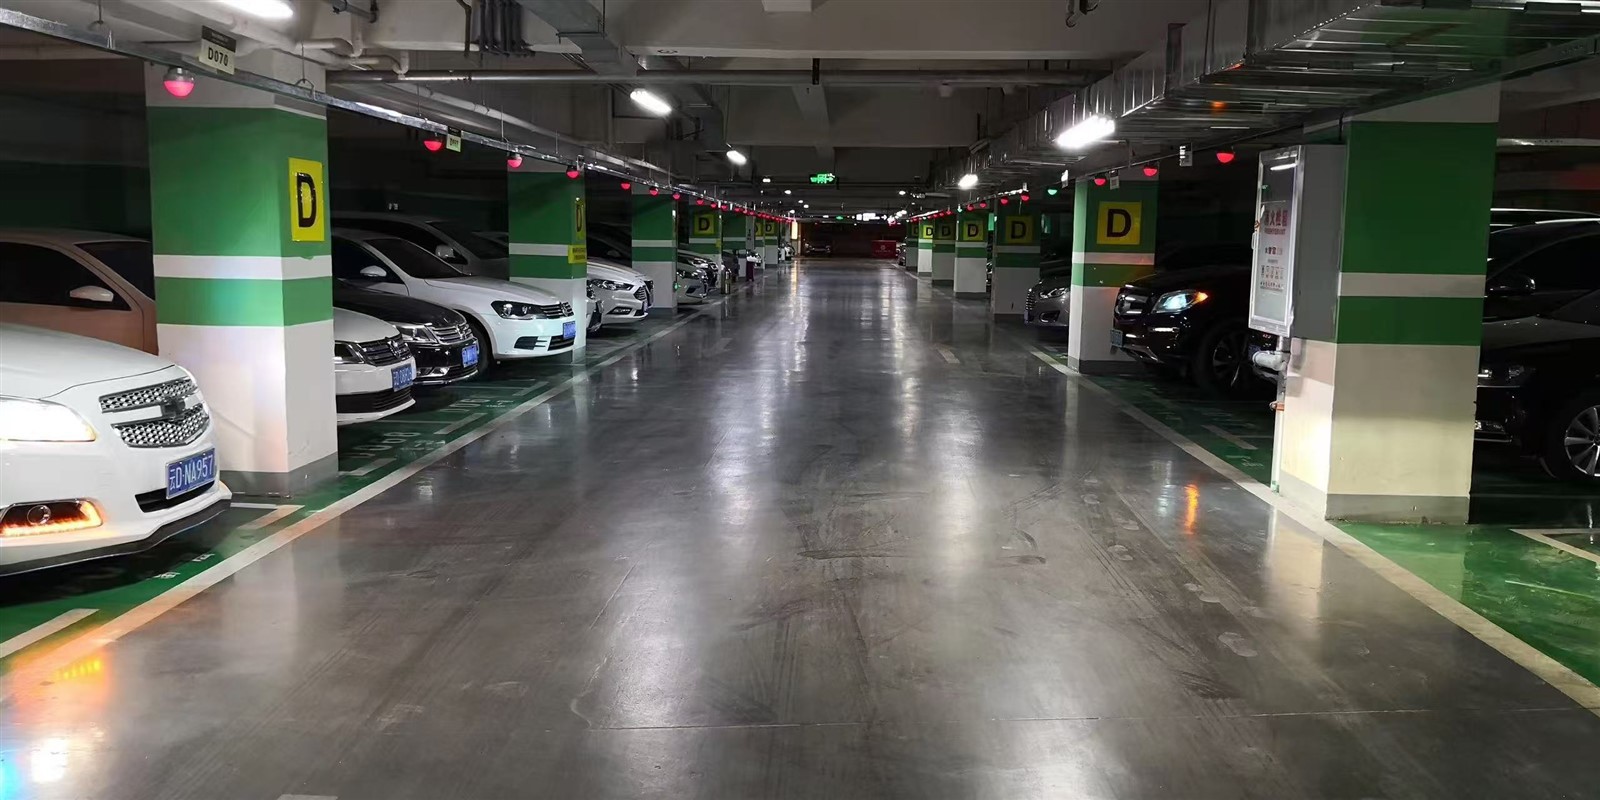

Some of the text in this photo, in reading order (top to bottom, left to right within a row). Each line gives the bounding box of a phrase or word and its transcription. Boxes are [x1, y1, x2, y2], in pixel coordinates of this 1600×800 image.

[208, 46, 228, 66] D070
[296, 172, 316, 228] D
[576, 204, 582, 232] D
[699, 217, 710, 231] D
[1106, 208, 1132, 238] D
[765, 223, 773, 232] D
[926, 226, 933, 236] D
[942, 225, 951, 237] D
[967, 223, 979, 237] D
[1011, 220, 1027, 239] D
